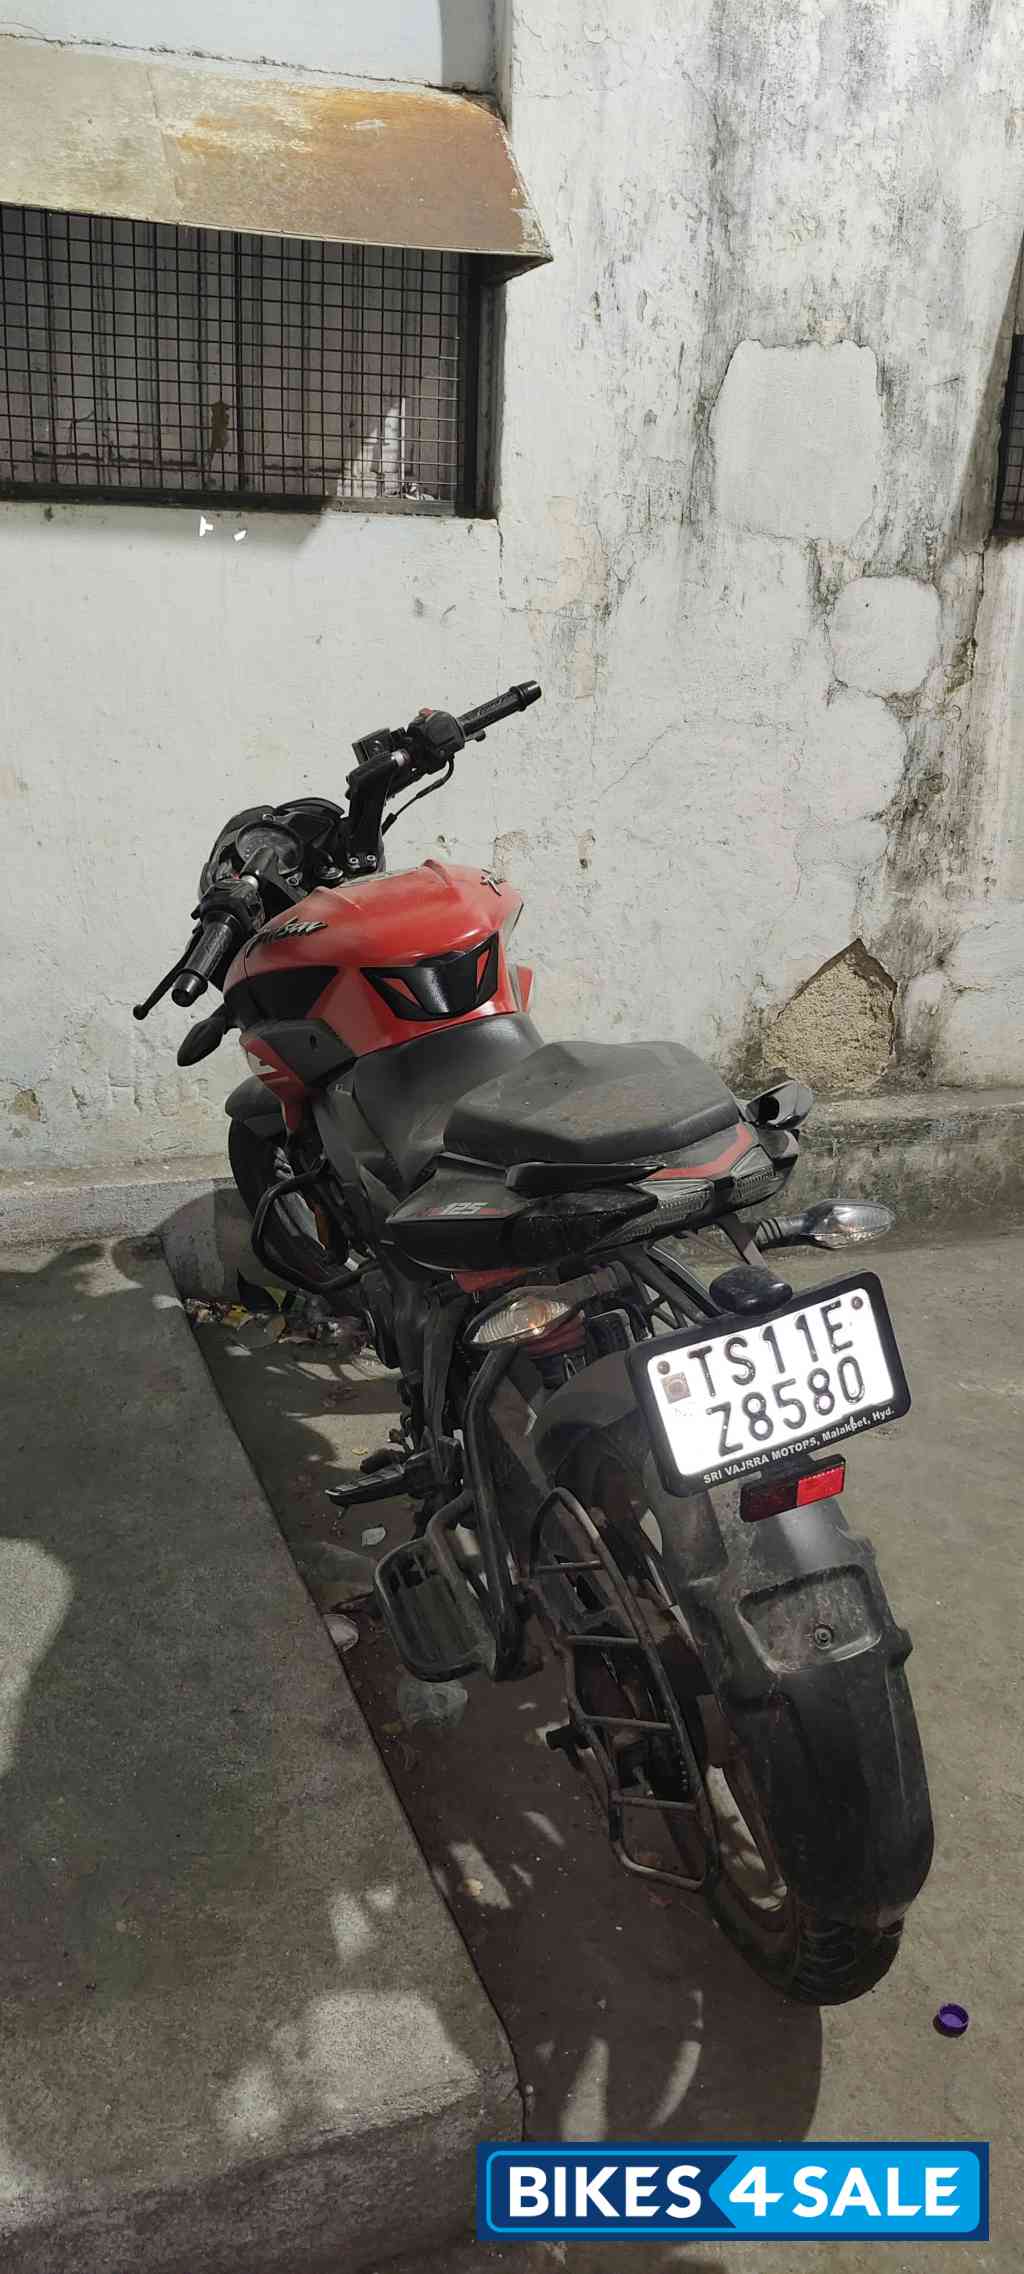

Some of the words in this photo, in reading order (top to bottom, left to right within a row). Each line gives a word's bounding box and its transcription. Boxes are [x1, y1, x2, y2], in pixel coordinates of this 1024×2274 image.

[687, 1300, 853, 1397] TS11E
[703, 1470, 723, 1485] SRI
[725, 1455, 770, 1476] VAJRRA
[872, 1405, 895, 1421] Hyd.
[705, 1355, 866, 1456] Z8580
